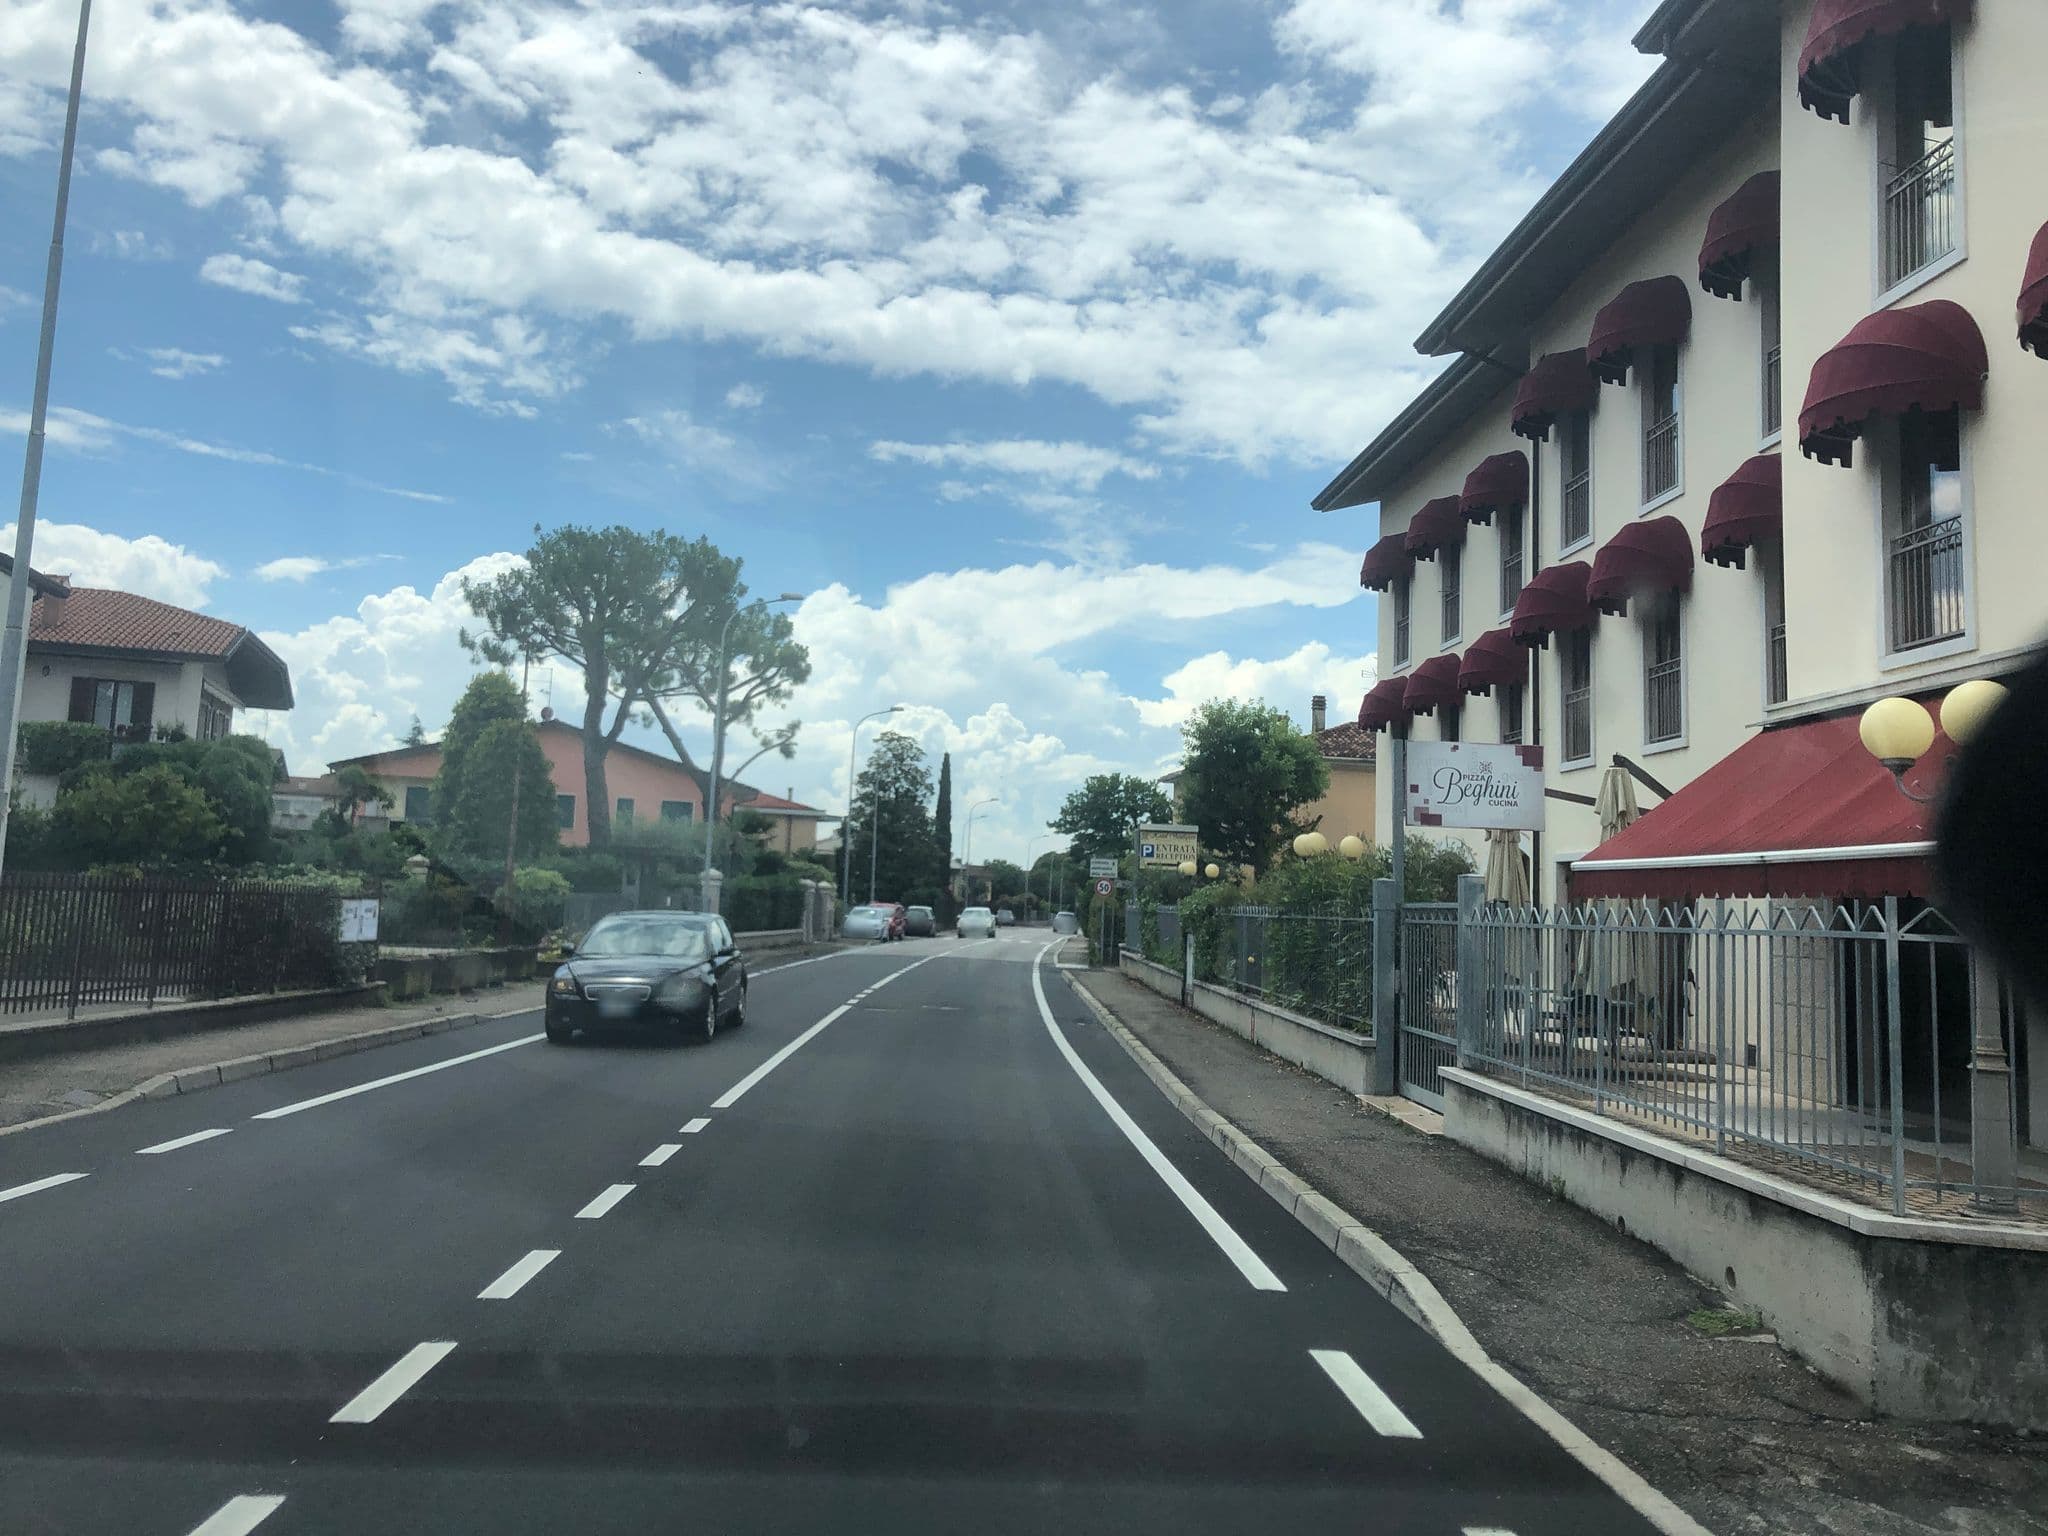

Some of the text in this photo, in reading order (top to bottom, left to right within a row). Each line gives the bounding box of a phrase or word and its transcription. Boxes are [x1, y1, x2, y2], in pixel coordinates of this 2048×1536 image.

[1462, 773, 1486, 782] PIZZA
[1433, 766, 1520, 806] Beghini
[1488, 799, 1519, 808] CUCINA
[1142, 845, 1153, 857] P
[1156, 843, 1196, 854] ENTRATA
[1156, 853, 1196, 862] RECEPTION
[1099, 882, 1109, 892] 50
